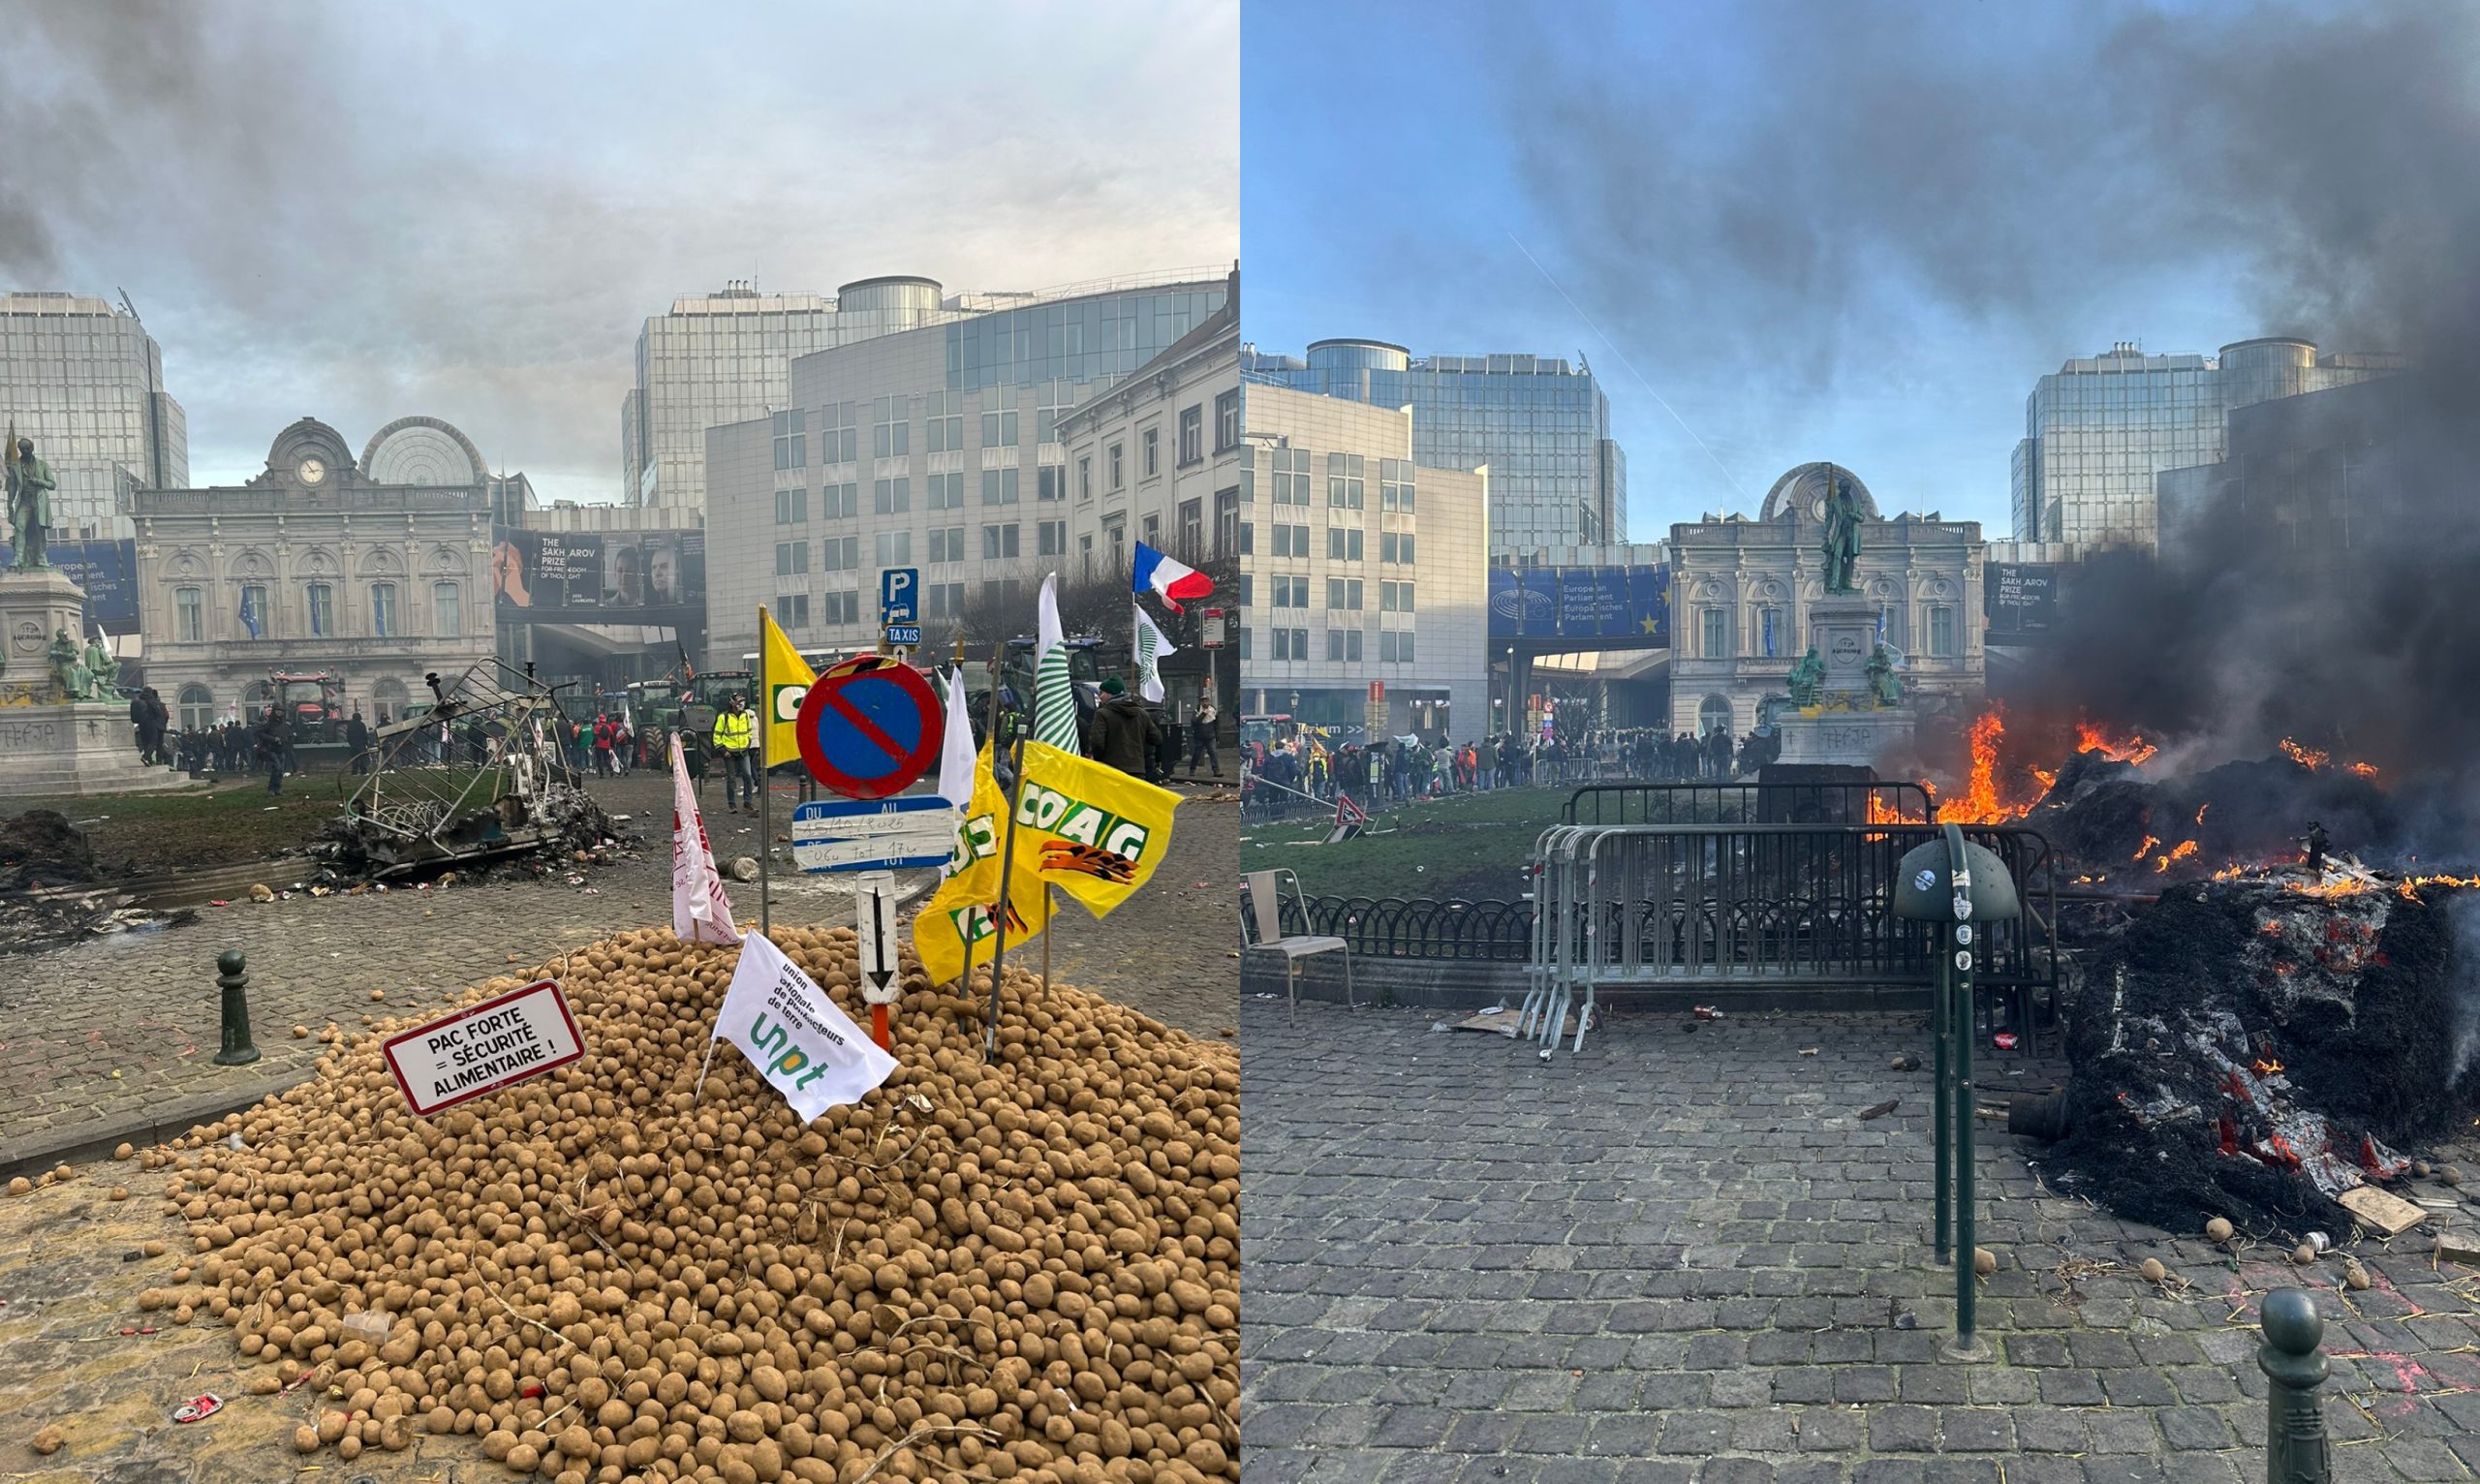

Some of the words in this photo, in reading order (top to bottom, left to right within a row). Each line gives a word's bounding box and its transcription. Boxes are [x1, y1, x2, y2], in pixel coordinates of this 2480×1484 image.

[542, 538, 559, 547] THE
[542, 547, 596, 558] SAKHAROV
[542, 557, 566, 566] PRIZE
[2001, 569, 2017, 577] THE
[889, 572, 911, 603] P
[2000, 577, 2049, 587] SAKHAROV
[1563, 585, 1607, 594] European
[2000, 585, 2022, 594] PRIZE
[889, 629, 918, 641] TAXIS
[805, 807, 822, 820] DU
[1016, 782, 1146, 864] COAG
[783, 963, 808, 990] union
[773, 986, 787, 1002] de
[767, 997, 782, 1009] de
[781, 1005, 803, 1030] terre
[427, 1030, 464, 1055] PAC
[466, 1006, 525, 1040] FORTE
[451, 1022, 538, 1067] SÉCURITÉ
[750, 1011, 829, 1092] unpt
[433, 1044, 545, 1098] ALIMENTAIRE
